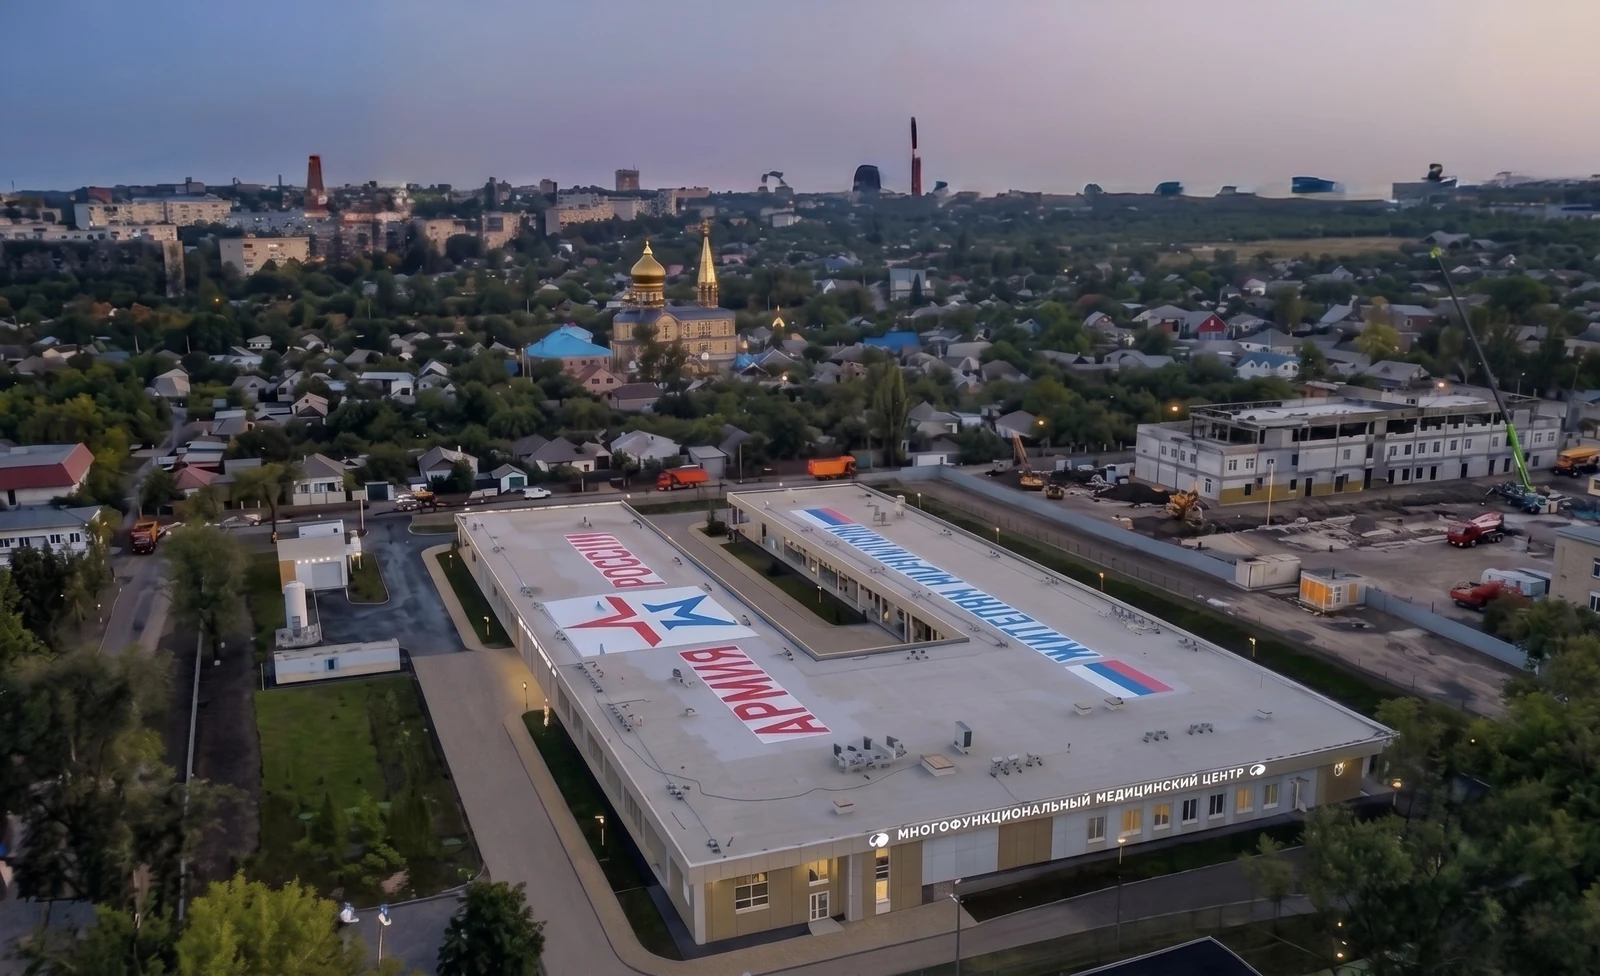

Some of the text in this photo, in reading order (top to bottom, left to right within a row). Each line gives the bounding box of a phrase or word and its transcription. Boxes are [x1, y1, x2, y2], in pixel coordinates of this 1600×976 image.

[681, 645, 831, 735] АРМИЯ
[897, 767, 1245, 841] МНОГОФУНКЦИОНАЛЬНЫЙ МЕДИЦИНСКИЙ ЦЕНТР
